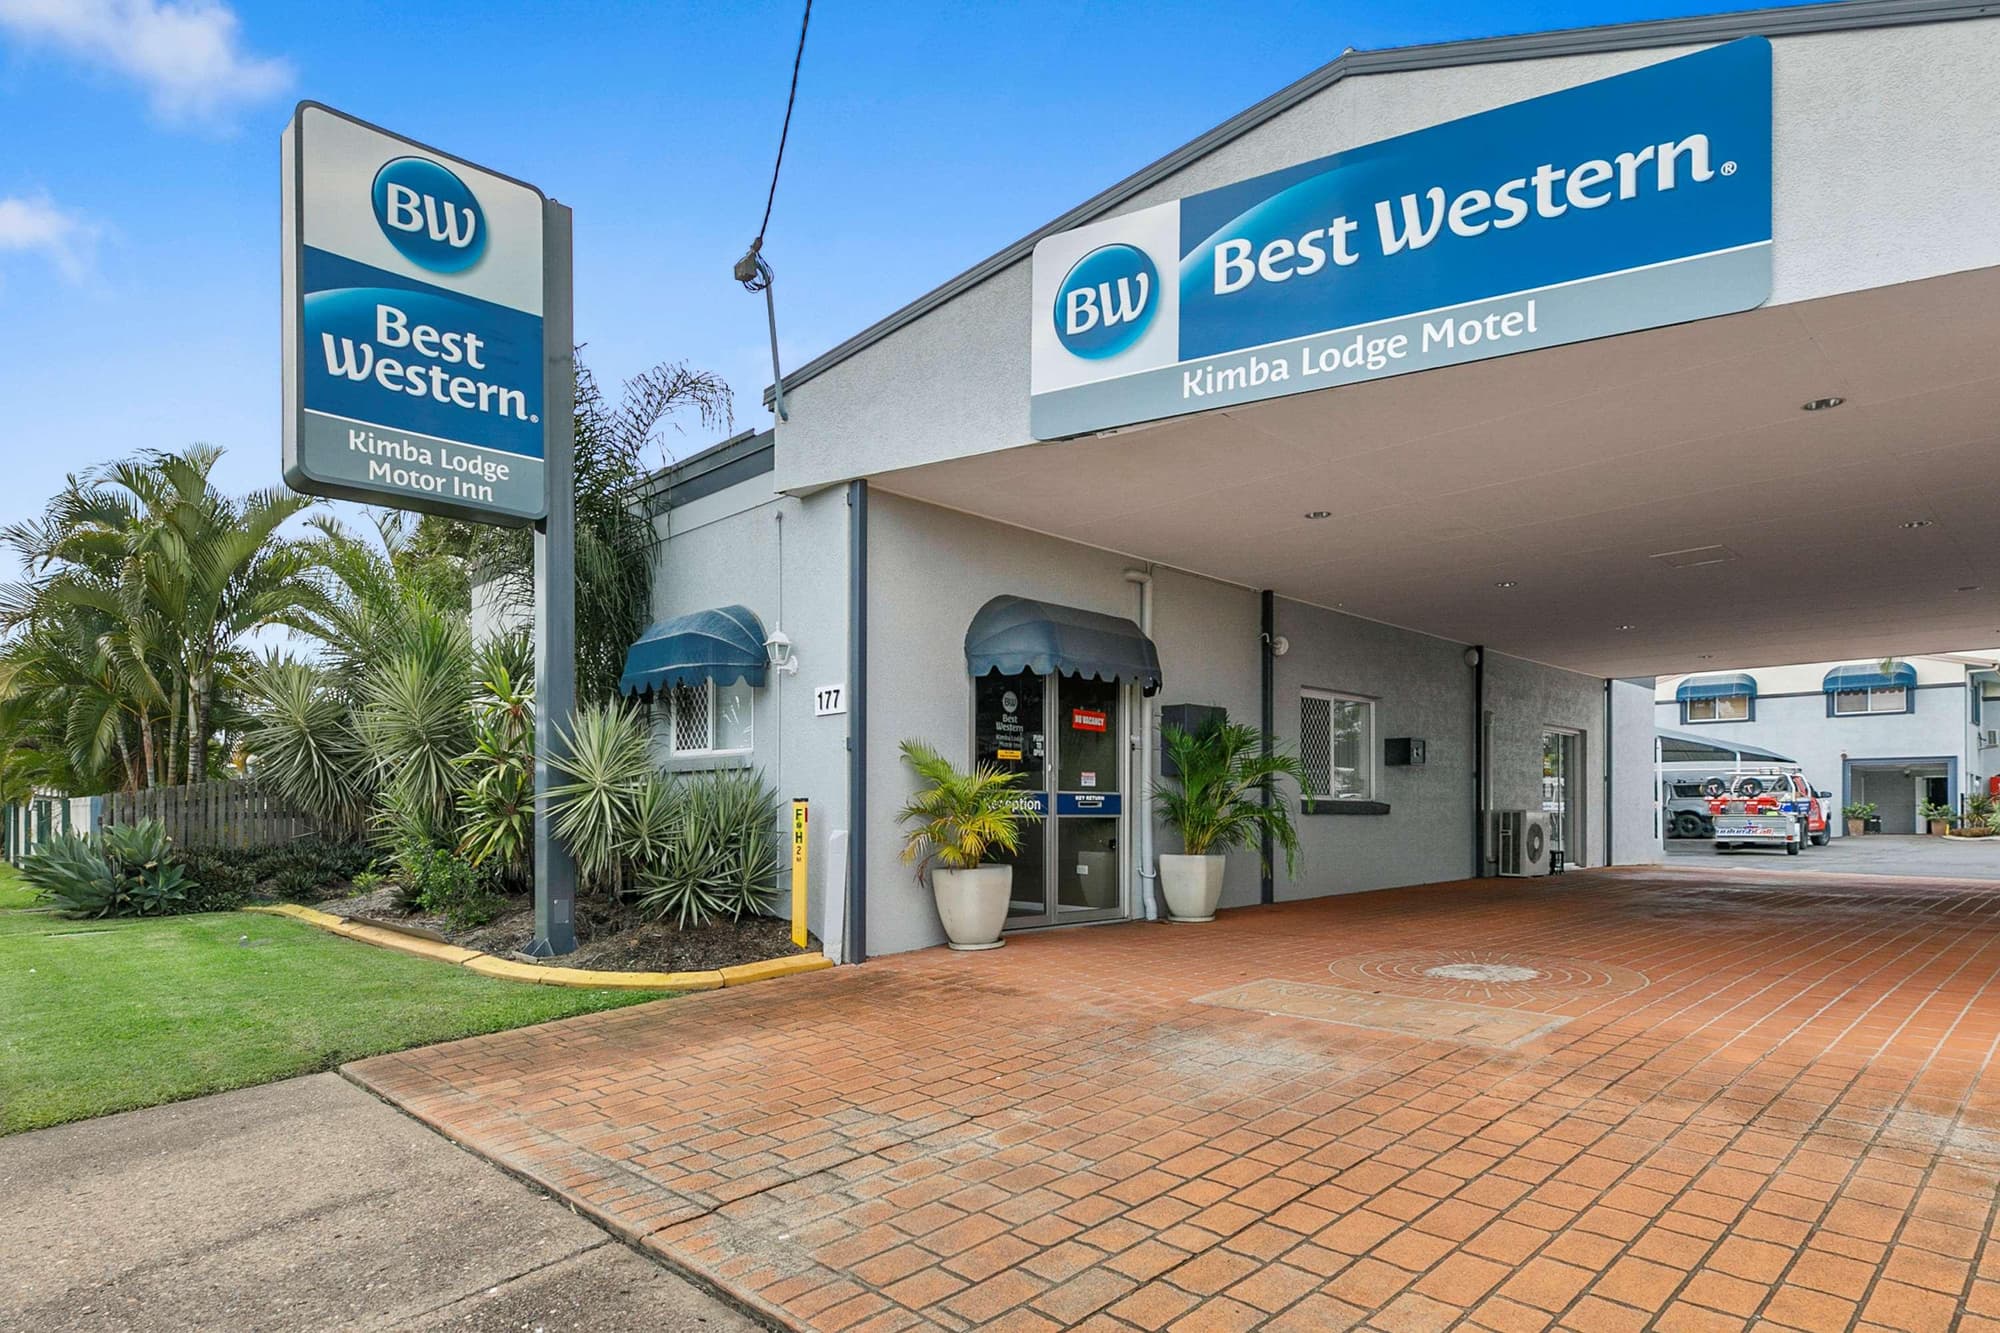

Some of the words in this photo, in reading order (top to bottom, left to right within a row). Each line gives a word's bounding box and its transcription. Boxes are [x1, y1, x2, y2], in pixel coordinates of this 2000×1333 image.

[387, 183, 475, 249] BW
[1214, 216, 1359, 296] Best
[1375, 132, 1715, 256] Western
[376, 303, 485, 370] Best
[1066, 272, 1150, 337] BW
[322, 332, 529, 423] Western
[1183, 354, 1289, 399] Kimba
[1302, 331, 1408, 379] Lodge
[1421, 301, 1538, 354] Motel
[349, 429, 432, 466] Kimba
[441, 448, 510, 482] Lodge
[369, 459, 446, 494] Motor
[454, 476, 494, 502] Inn
[817, 689, 841, 711] 177
[996, 722, 1024, 732] Western
[1002, 714, 1018, 723] Best
